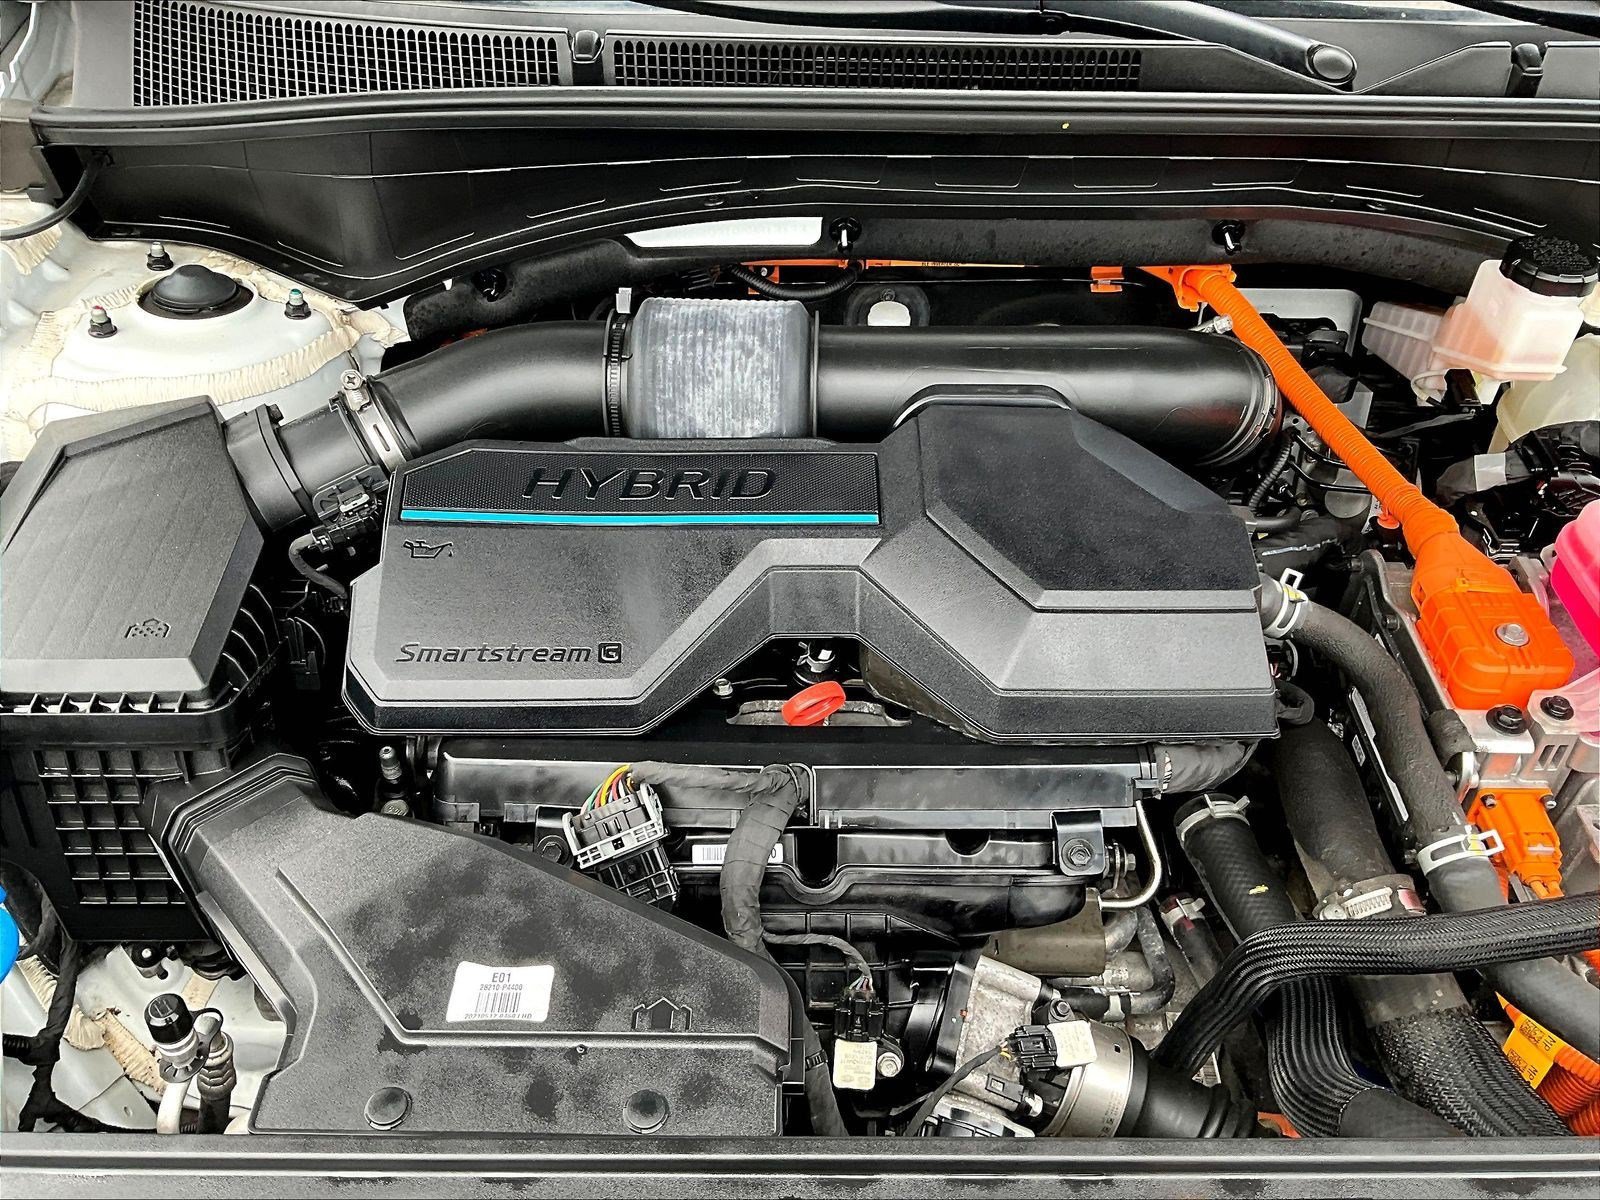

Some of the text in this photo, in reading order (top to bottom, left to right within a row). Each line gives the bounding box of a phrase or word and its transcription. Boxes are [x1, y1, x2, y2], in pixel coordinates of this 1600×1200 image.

[522, 468, 777, 500] HYBRID
[396, 642, 592, 663] Smartstream
[491, 972, 512, 983] E01
